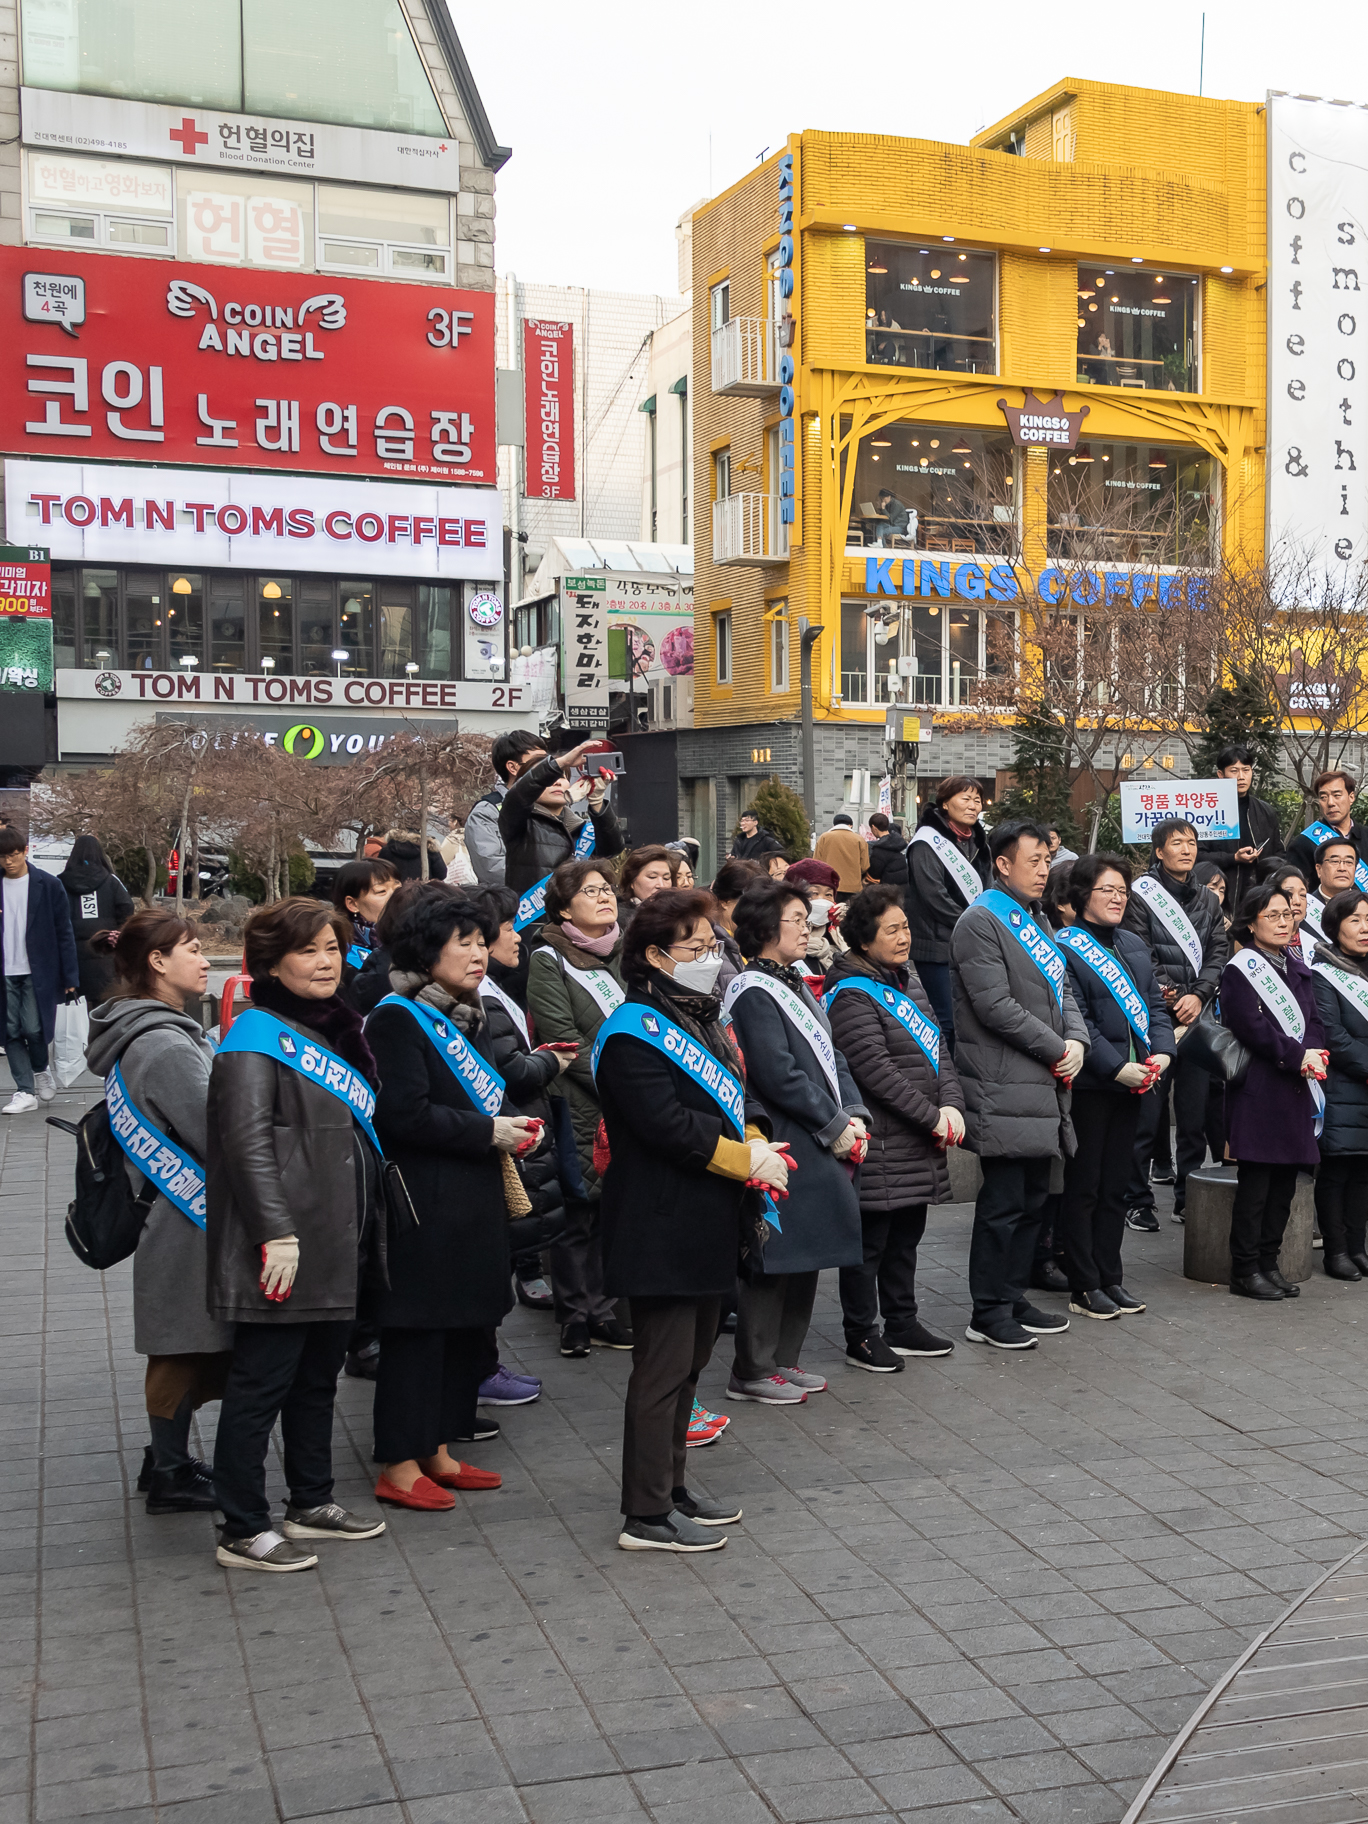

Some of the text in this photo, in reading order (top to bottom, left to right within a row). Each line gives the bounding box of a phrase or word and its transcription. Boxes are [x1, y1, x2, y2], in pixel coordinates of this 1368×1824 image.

[34, 131, 128, 150] 건대역센터 (02)498-4185
[217, 123, 316, 159] 헌혈의집
[219, 151, 316, 169] Blood Donation Center
[779, 154, 794, 300] KINGS
[32, 280, 78, 302] 천원에
[900, 283, 961, 296] KINGS COFFEE
[41, 299, 69, 317] 4곡
[224, 302, 296, 329] COIN
[1109, 305, 1166, 318] KINGS COFFEE
[426, 307, 475, 348] 3F
[535, 329, 564, 339] ANGEL
[541, 323, 557, 331] COIN
[199, 326, 326, 361] ANGEL
[24, 352, 476, 463] 코인 노래연습장
[1019, 415, 1061, 430] KINGS
[1019, 428, 1070, 443] COFFEE
[896, 464, 920, 473] KINGS
[541, 484, 561, 498] 3F
[1105, 480, 1161, 490] KINGS COFFEE
[29, 493, 489, 549] TOM N TOMS COFFEE
[28, 549, 46, 561] B1
[865, 557, 1210, 611] KINGS COFFEE
[575, 594, 603, 689] 돼지한마리
[131, 673, 523, 709] TOM N TOMS COFFEE 2F
[570, 708, 607, 717] 생삼겹살
[570, 720, 607, 729] 돼지갈비
[1140, 792, 1219, 811] 명품 화양동
[1185, 810, 1226, 827] Day!!
[1171, 915, 1187, 934] 점포
[1248, 962, 1267, 979] 광진구
[595, 980, 615, 1001] 점포
[1282, 1003, 1299, 1025] 점포
[789, 999, 805, 1022] 점포
[813, 1029, 833, 1062] 청소는
[1290, 1021, 1302, 1035] 앞
